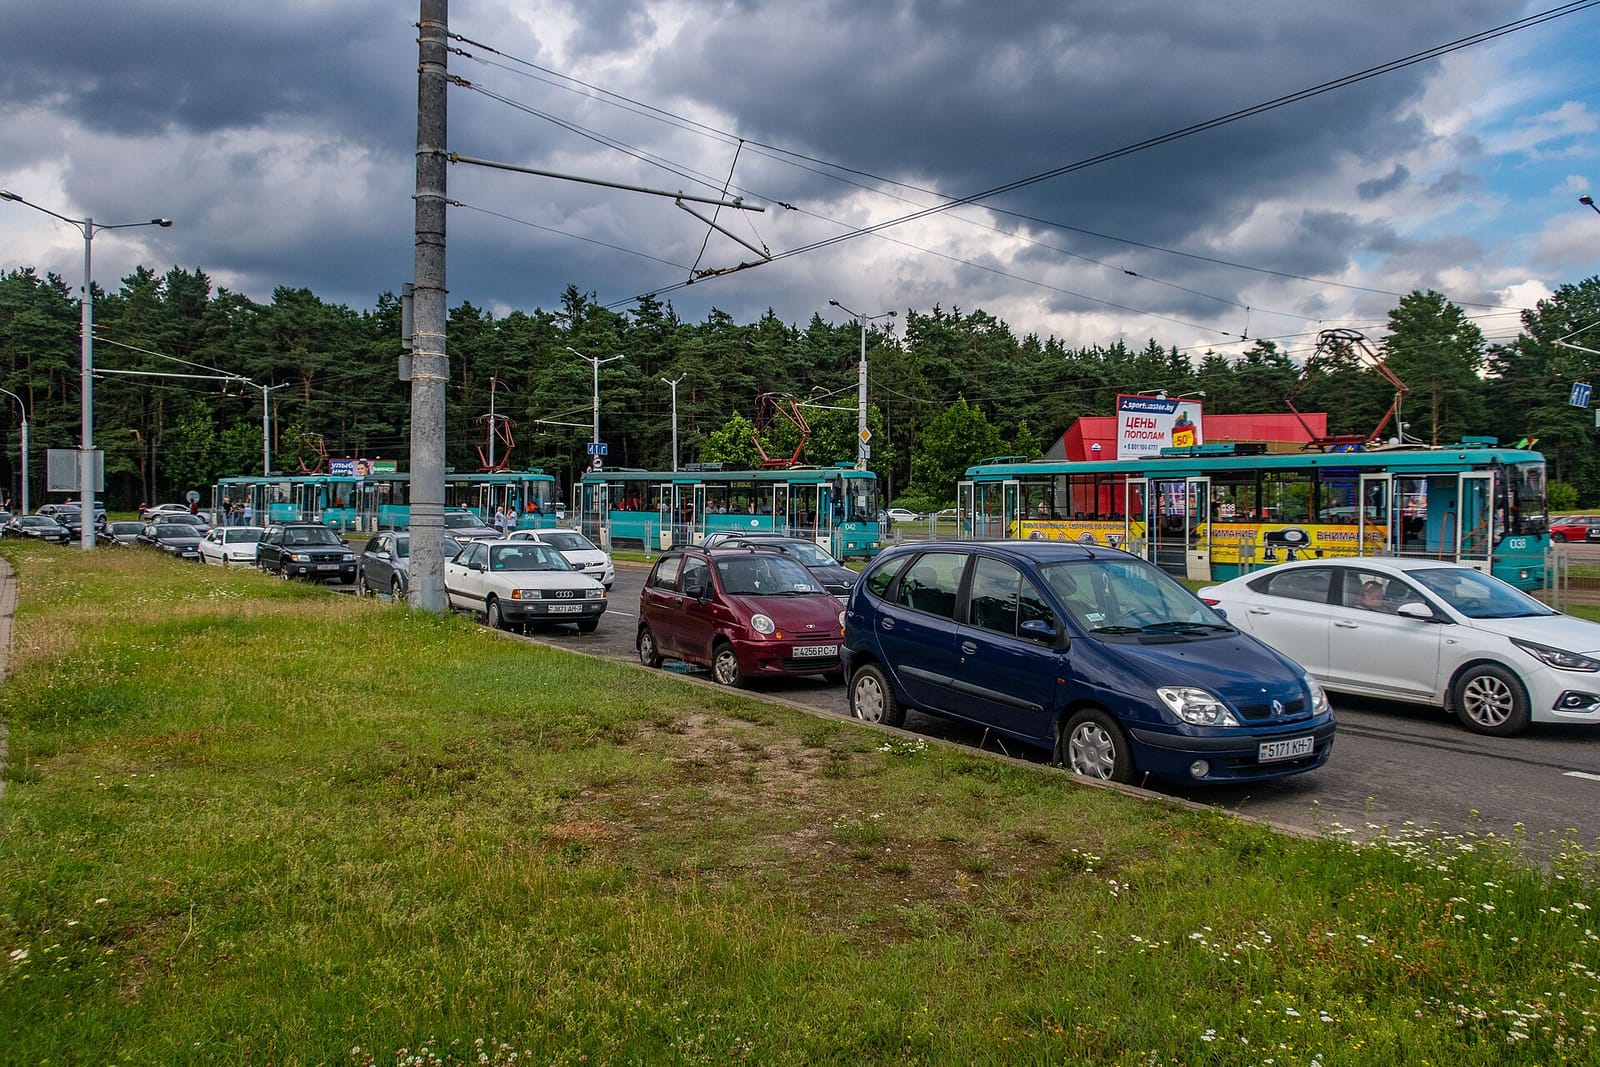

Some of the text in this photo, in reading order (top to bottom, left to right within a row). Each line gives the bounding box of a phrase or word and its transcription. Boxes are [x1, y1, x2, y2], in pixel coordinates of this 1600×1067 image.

[1125, 417, 1157, 429] ЦЕНЫ
[1124, 430, 1165, 440] ПОПОЛАМ
[845, 523, 857, 531] 042
[800, 647, 818, 656] 4256
[1268, 738, 1313, 757] 5171 KH-7
